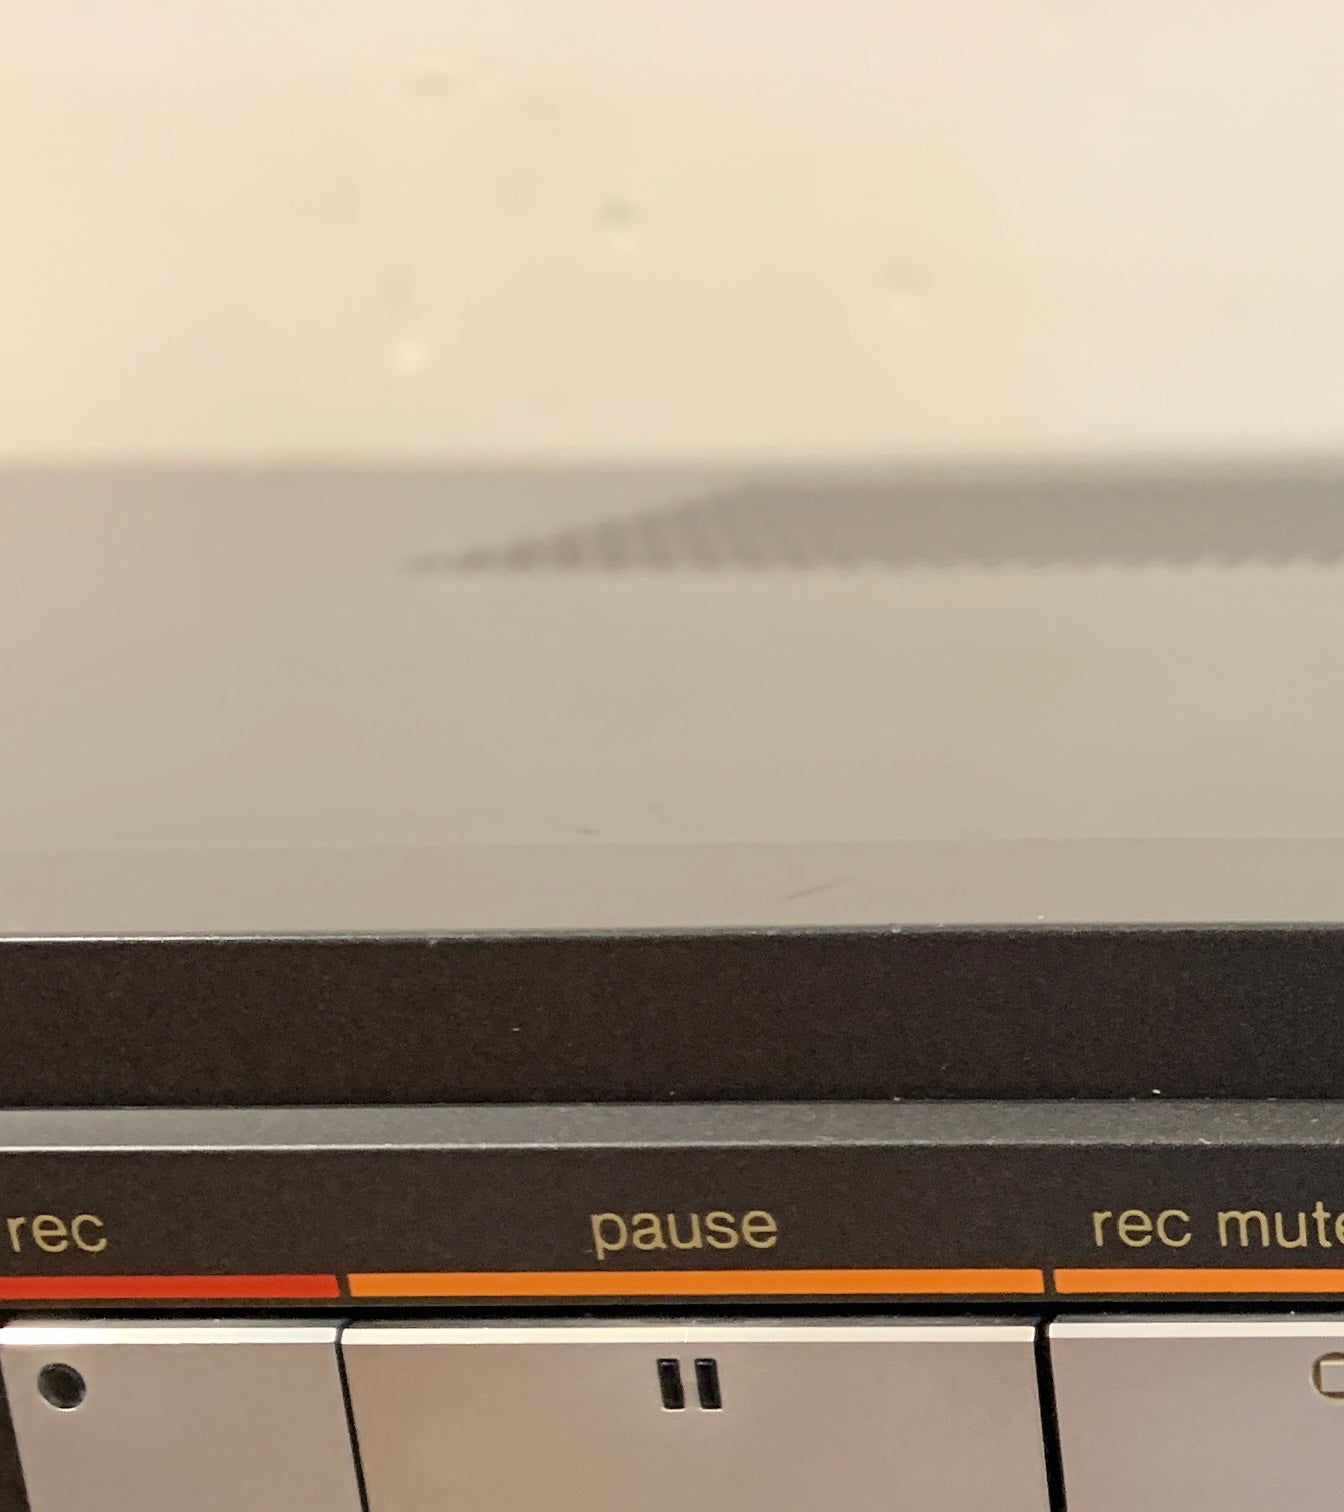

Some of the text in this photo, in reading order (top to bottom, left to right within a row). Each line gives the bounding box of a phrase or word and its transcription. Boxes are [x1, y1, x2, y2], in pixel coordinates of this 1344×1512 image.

[5, 1212, 108, 1254] rec
[590, 1210, 778, 1261] pause
[1092, 1208, 1191, 1248] rec
